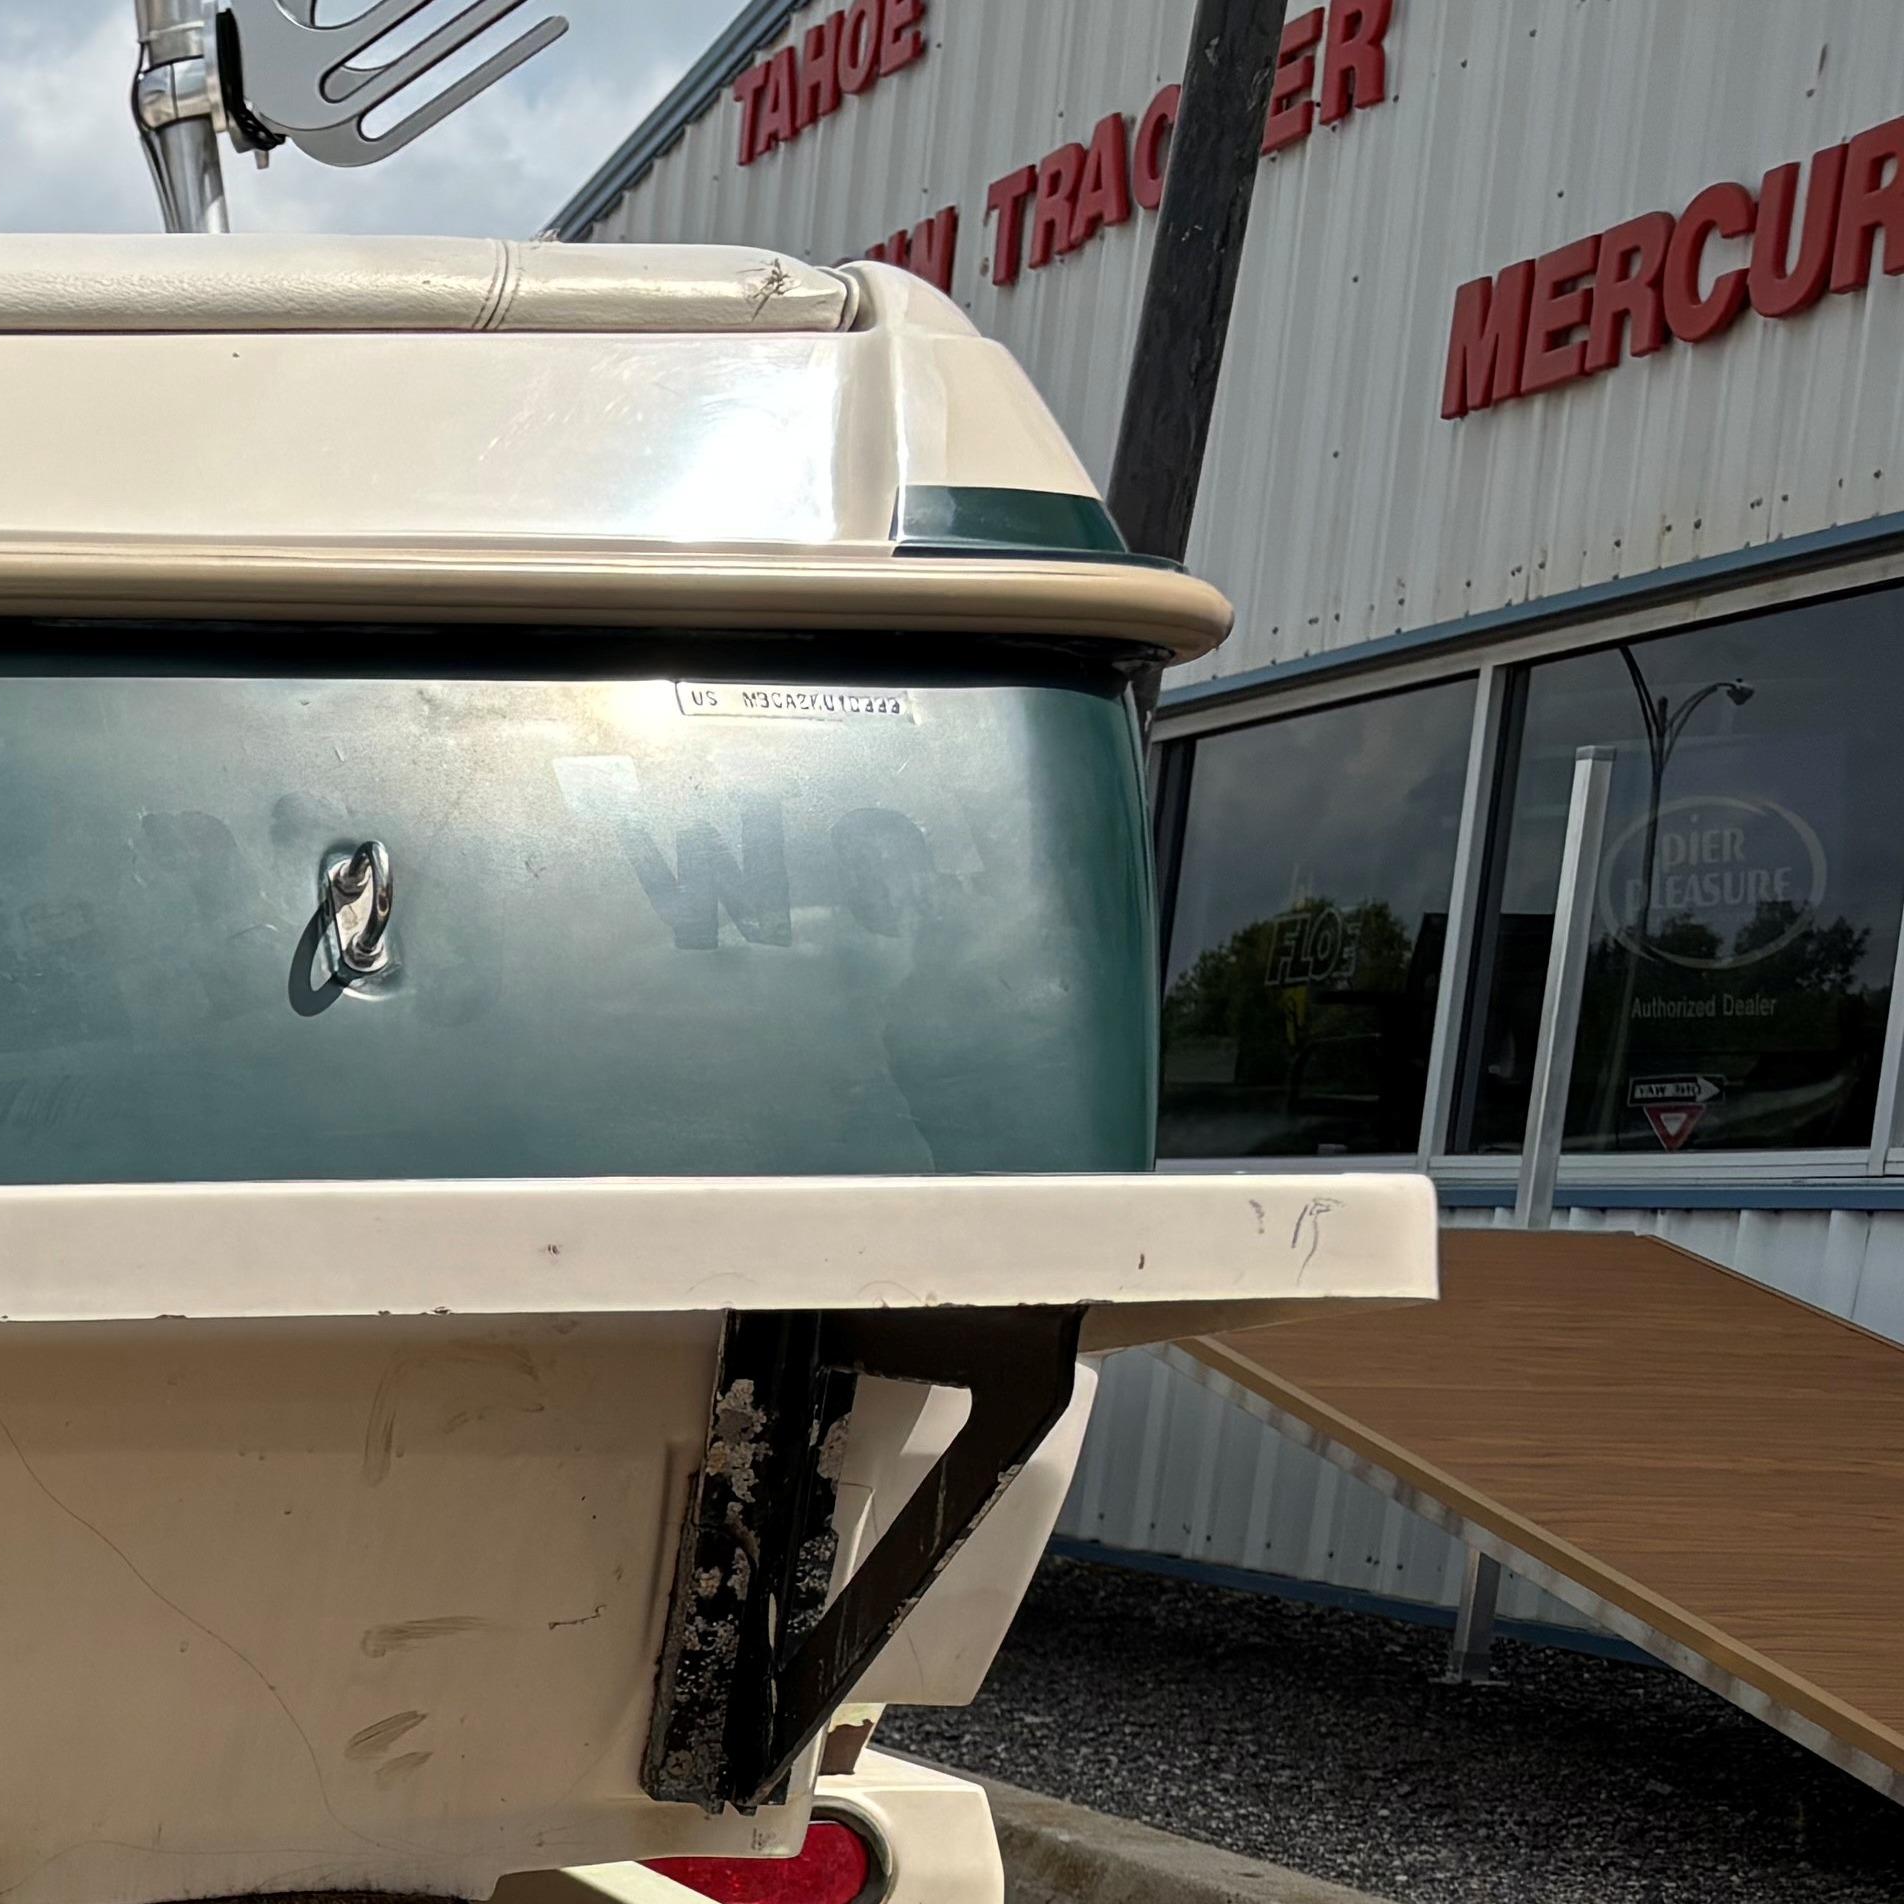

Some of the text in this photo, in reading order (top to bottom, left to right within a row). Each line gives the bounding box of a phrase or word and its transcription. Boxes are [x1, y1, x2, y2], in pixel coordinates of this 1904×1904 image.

[733, 0, 926, 167] TAHOE
[988, 0, 1392, 287] TRACER
[692, 691, 718, 706] US
[1632, 993, 1777, 1018] Authorized Dealer
